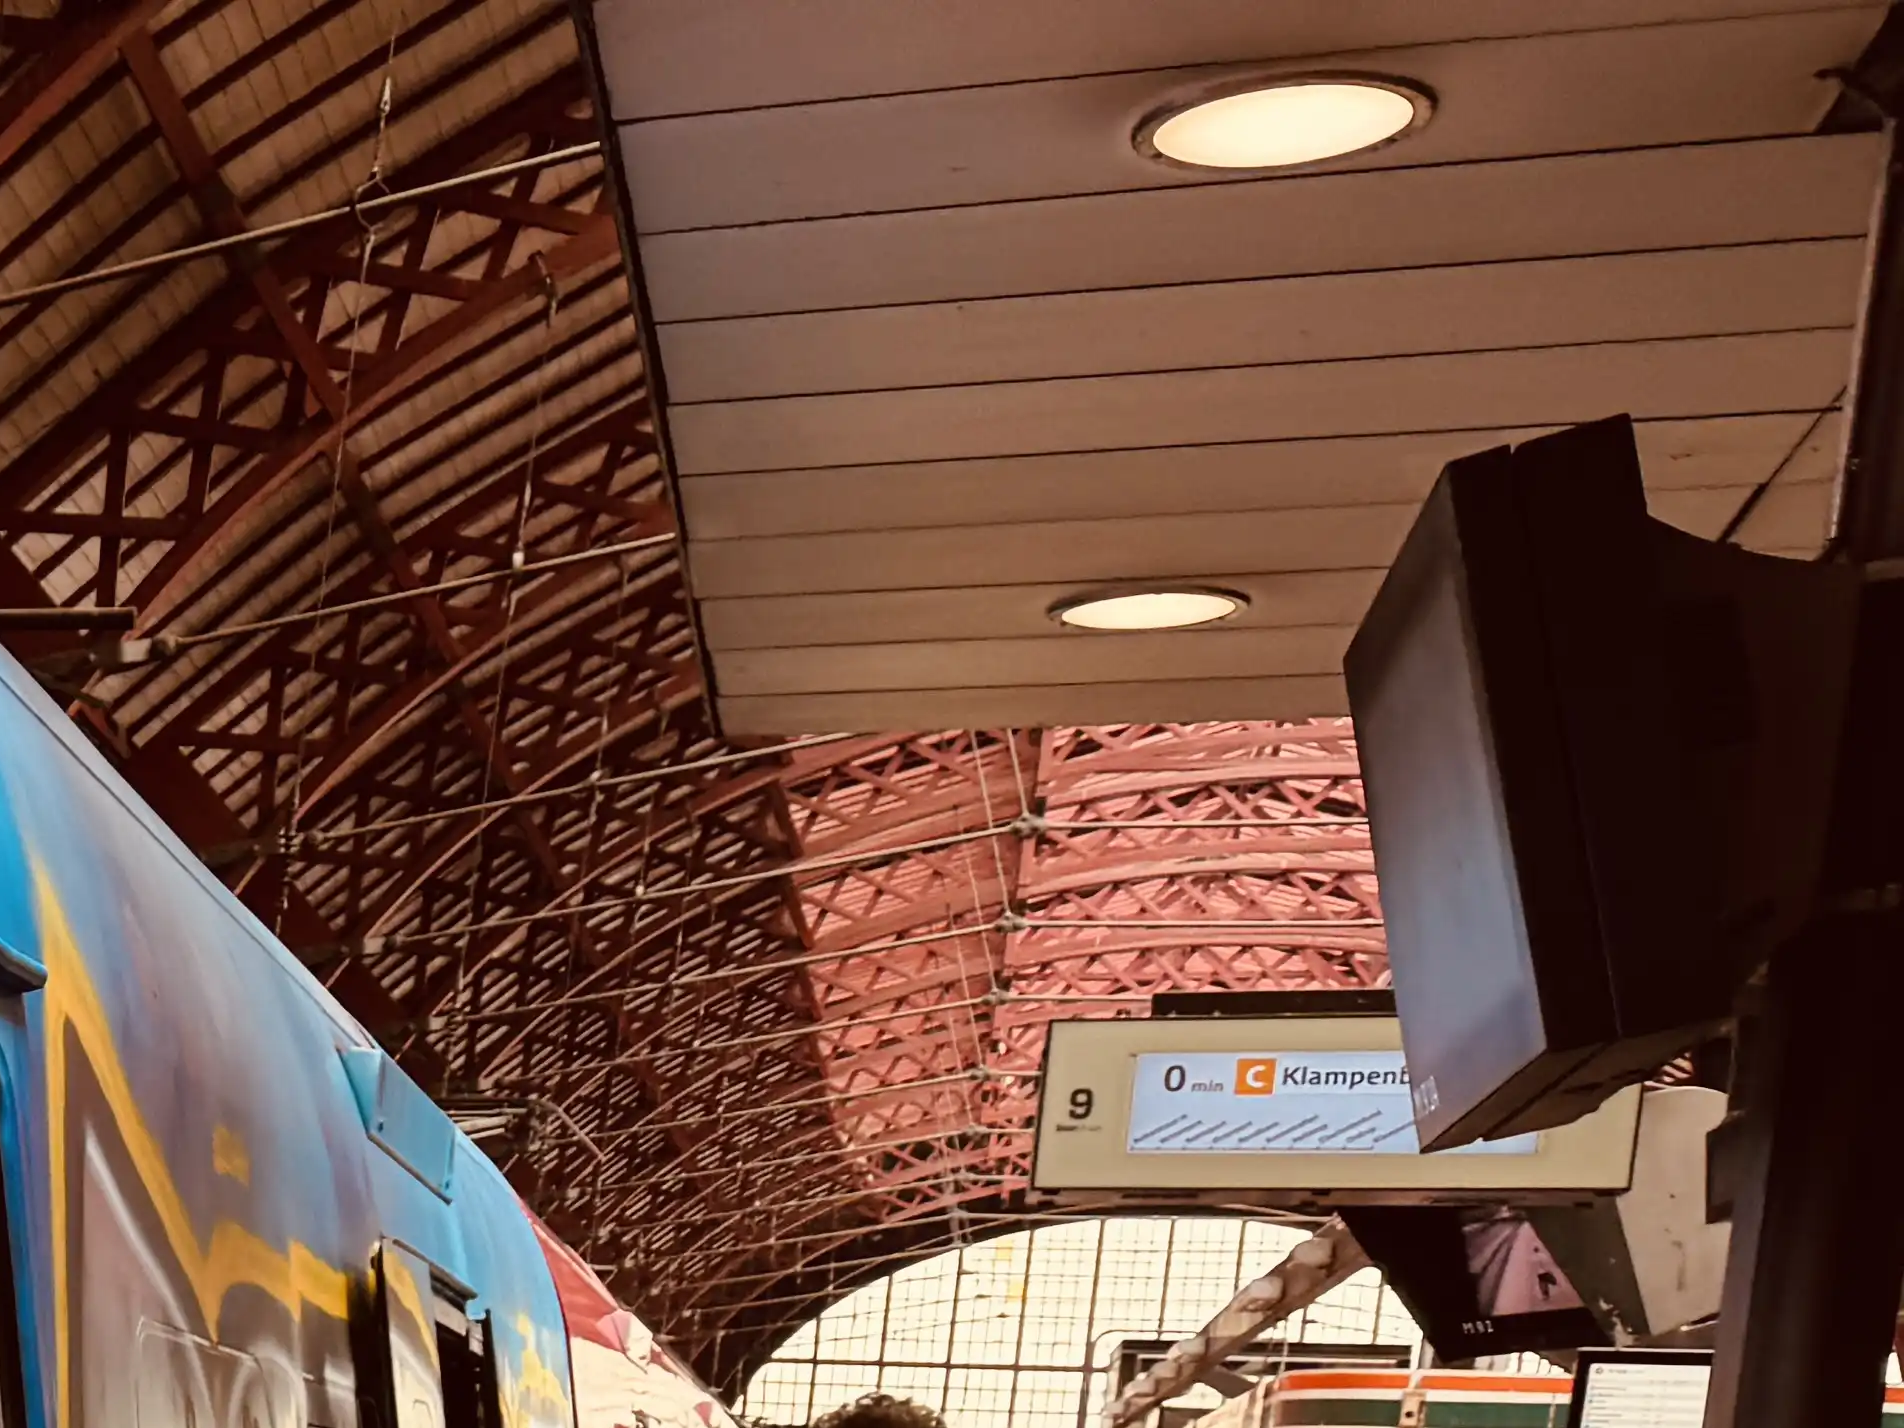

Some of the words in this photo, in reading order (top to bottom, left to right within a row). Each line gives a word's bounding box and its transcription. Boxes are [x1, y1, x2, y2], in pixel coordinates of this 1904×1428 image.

[1163, 1065, 1187, 1092] 0
[1191, 1079, 1224, 1093] min
[1245, 1064, 1268, 1089] C
[1069, 1088, 1094, 1120] 9
